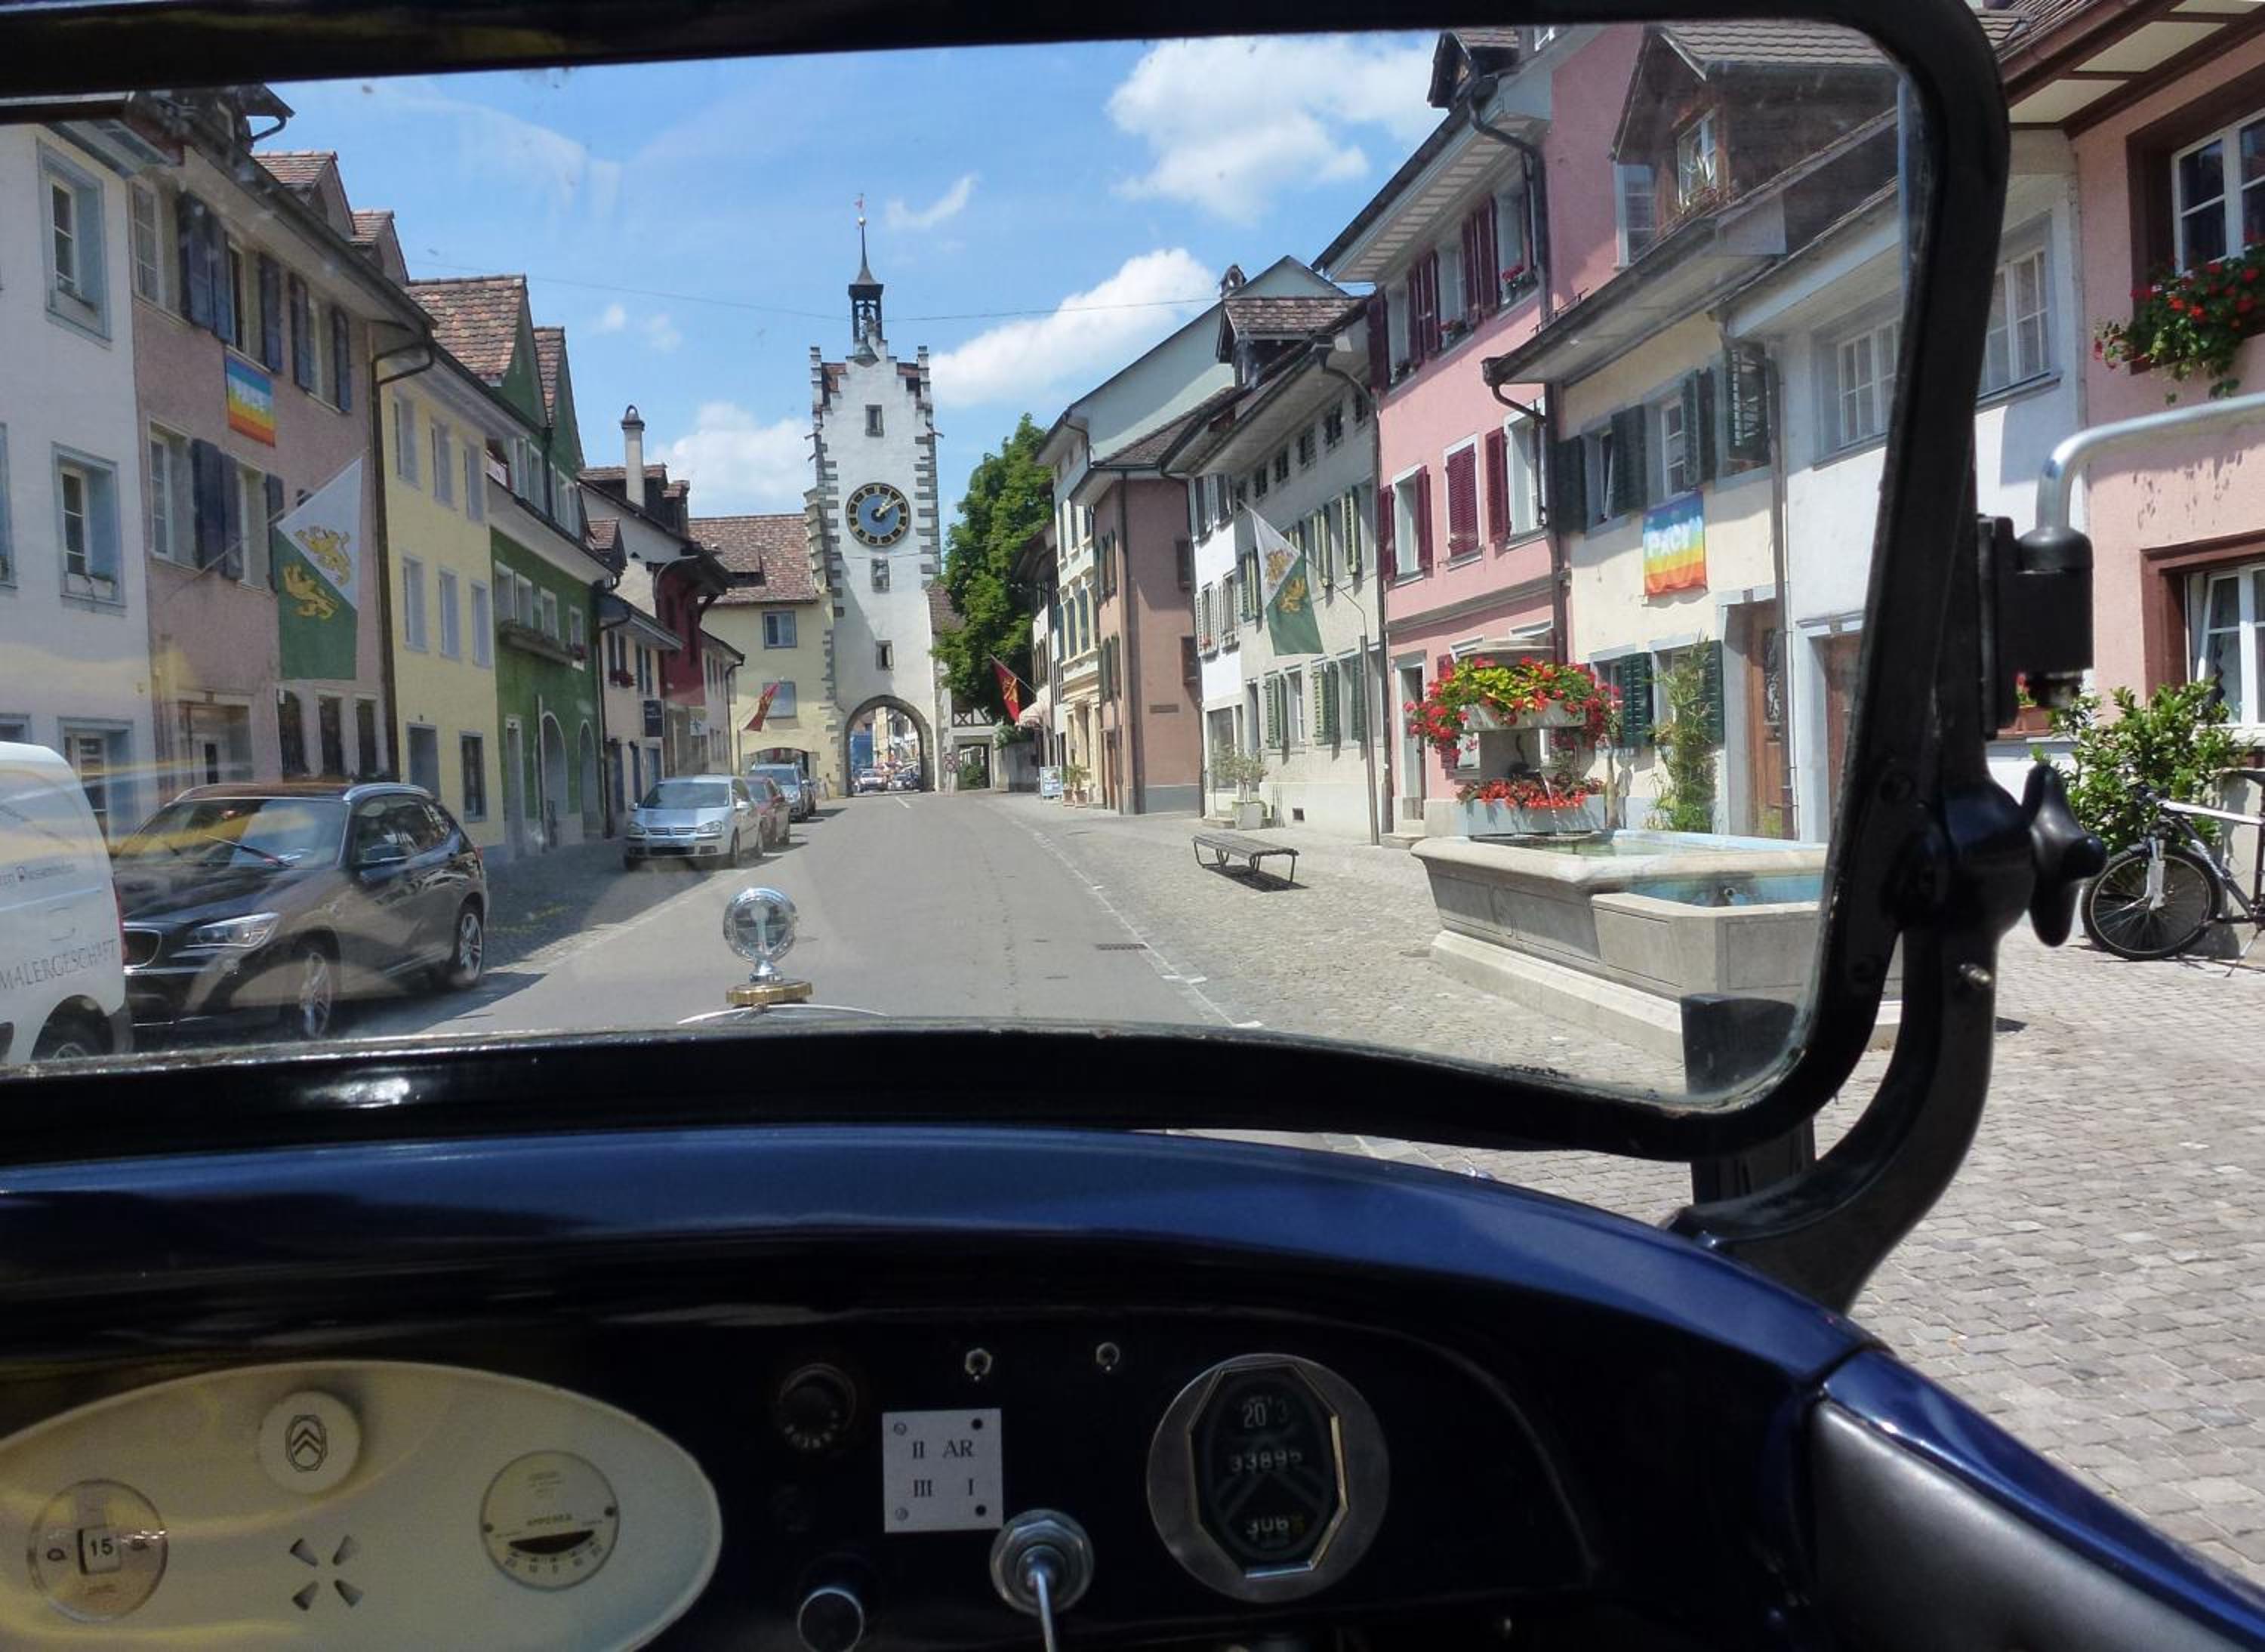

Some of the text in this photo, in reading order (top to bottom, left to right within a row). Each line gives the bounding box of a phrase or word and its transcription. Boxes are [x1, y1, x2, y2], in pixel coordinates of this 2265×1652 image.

[913, 1439, 975, 1459] II AR
[914, 1479, 932, 1498] III
[90, 1537, 114, 1557] 15
